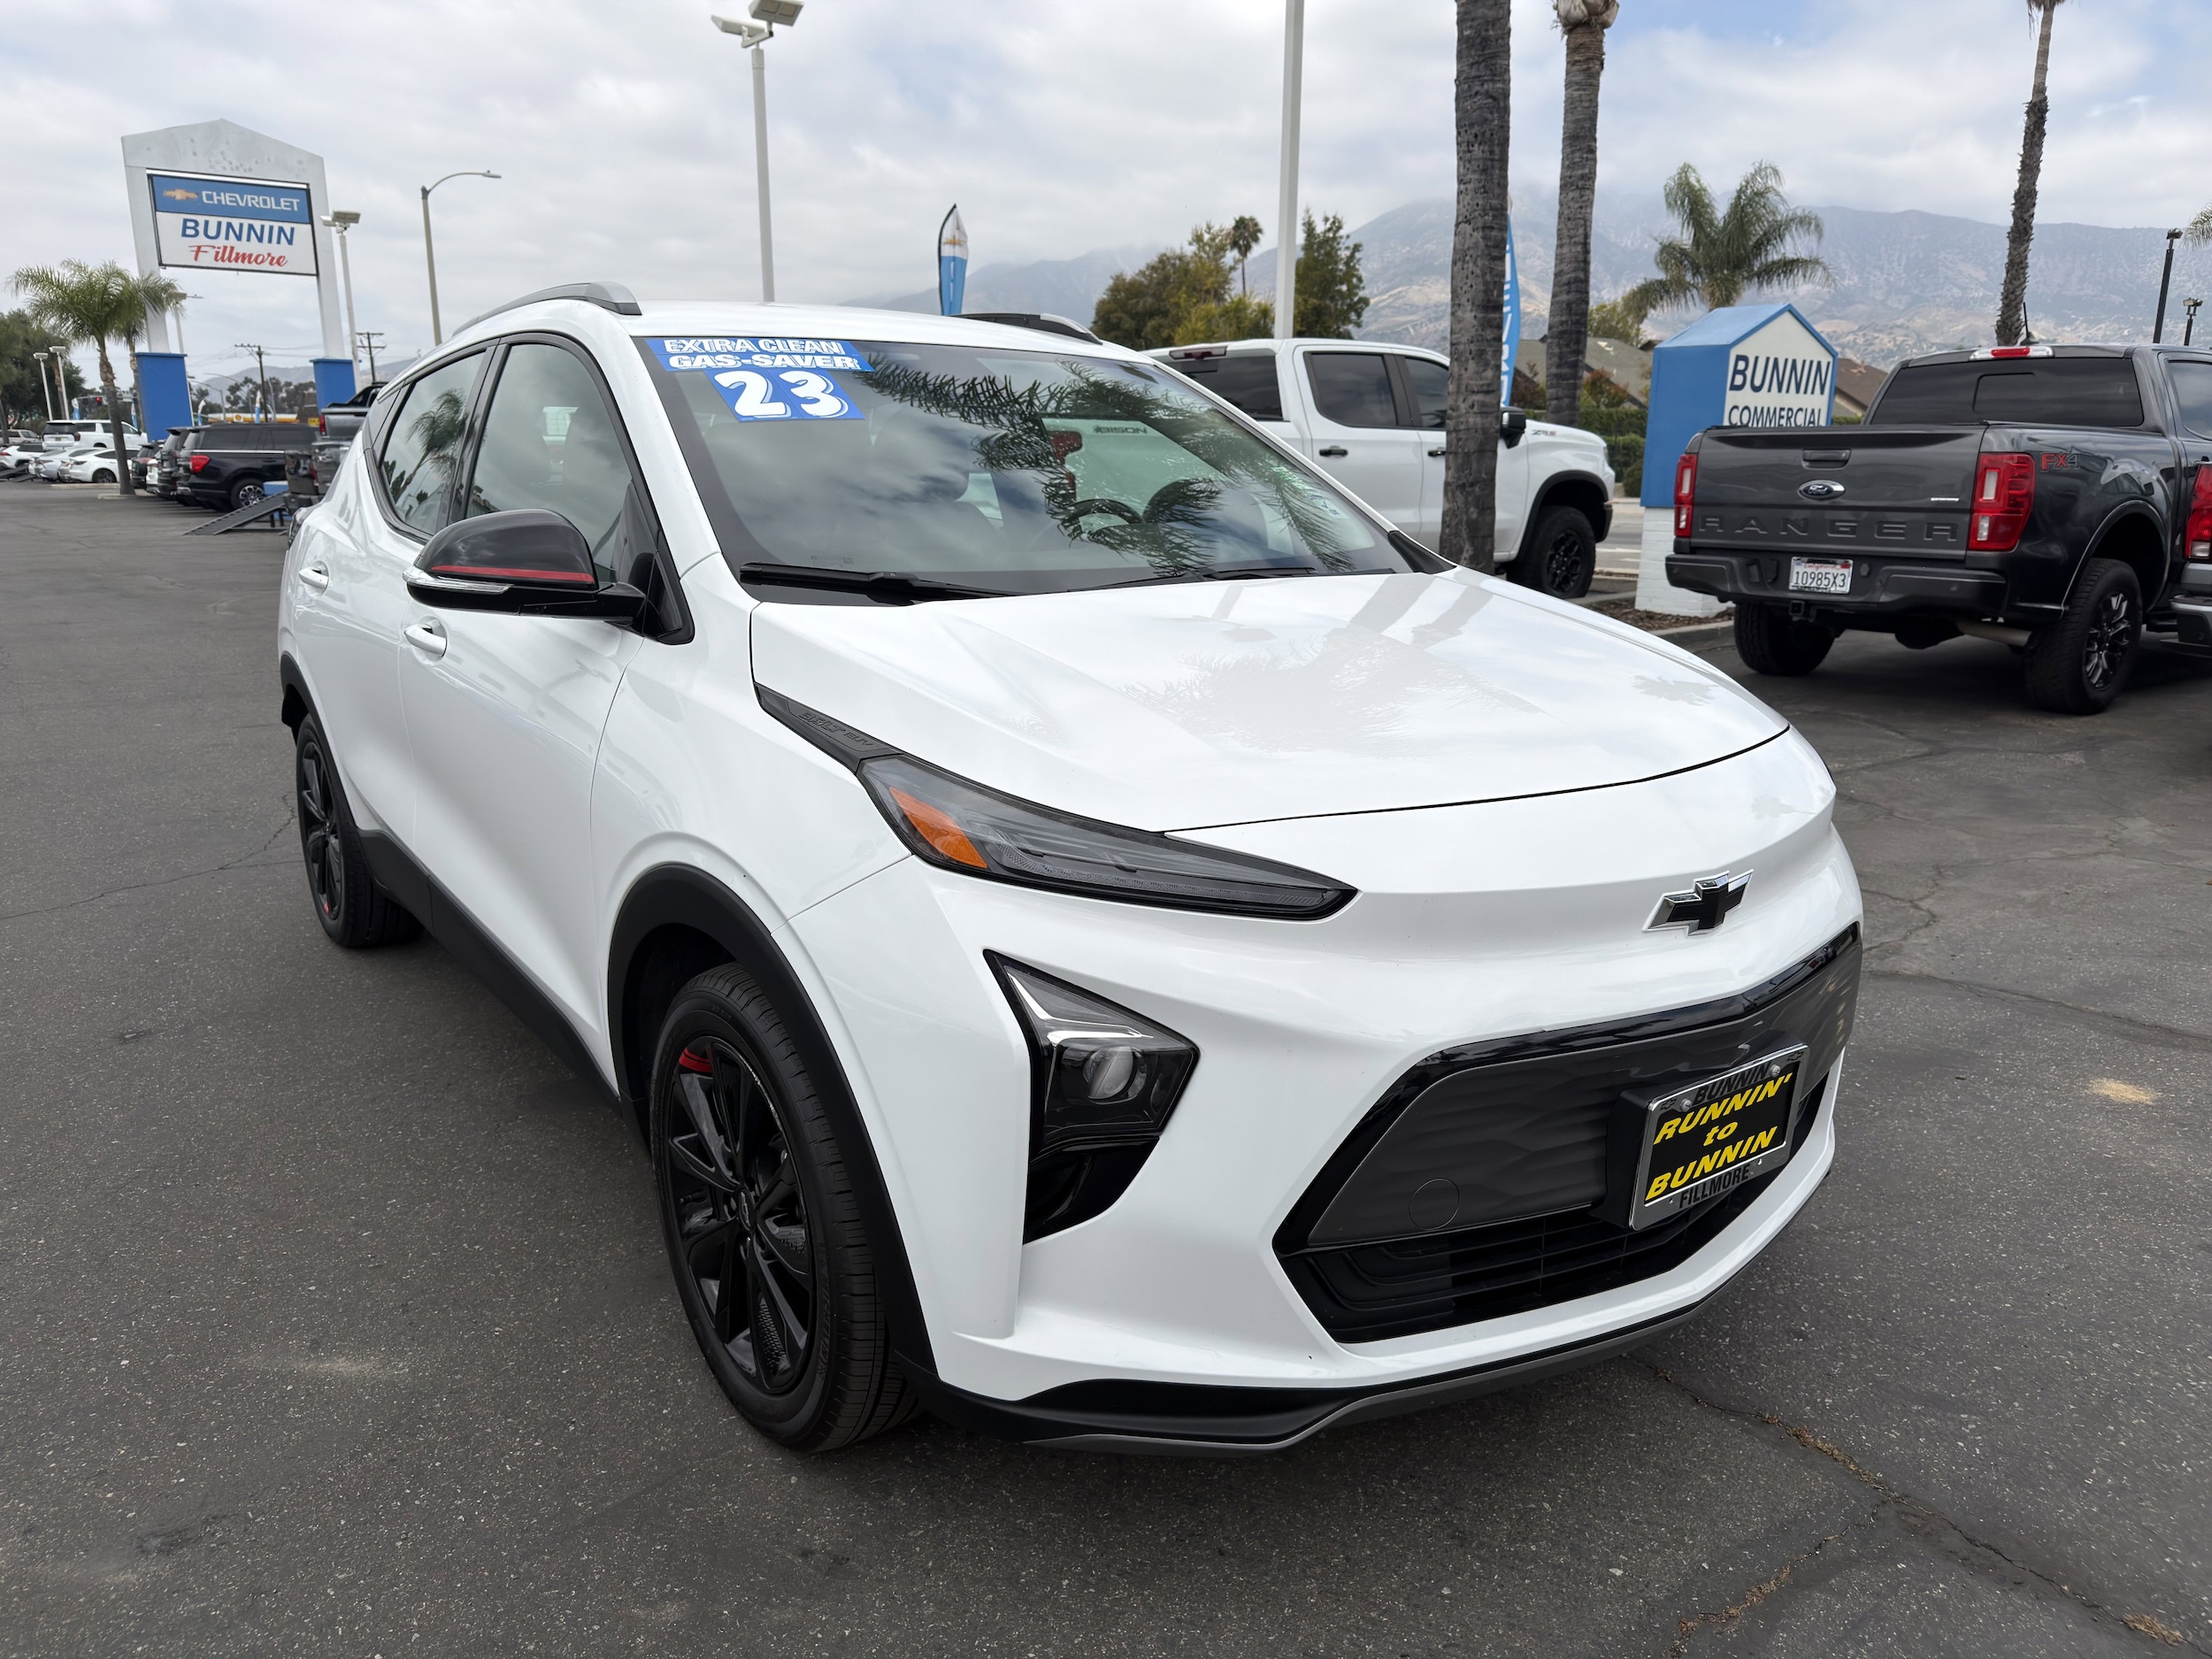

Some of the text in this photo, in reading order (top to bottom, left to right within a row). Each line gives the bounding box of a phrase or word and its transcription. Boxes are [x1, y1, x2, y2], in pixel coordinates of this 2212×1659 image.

[202, 190, 300, 211] CHEVROLET
[180, 218, 296, 246] BUNNIN
[188, 244, 288, 267] Fillmore
[664, 339, 846, 355] EXTRA CLEAN
[669, 354, 862, 369] GAS-SAVER
[1728, 354, 1831, 396] BUNNIN
[714, 370, 849, 419] 23
[2041, 452, 2080, 472] FX4
[1699, 515, 1958, 542] RANGER
[1793, 571, 1847, 588] 10985X3
[1693, 1061, 1770, 1105] BUNNIN
[1653, 1072, 1793, 1145] RUNNIN'
[1703, 1121, 1739, 1147] to
[1645, 1125, 1778, 1202] BUNNIN
[1678, 1163, 1751, 1210] FILLMORE
